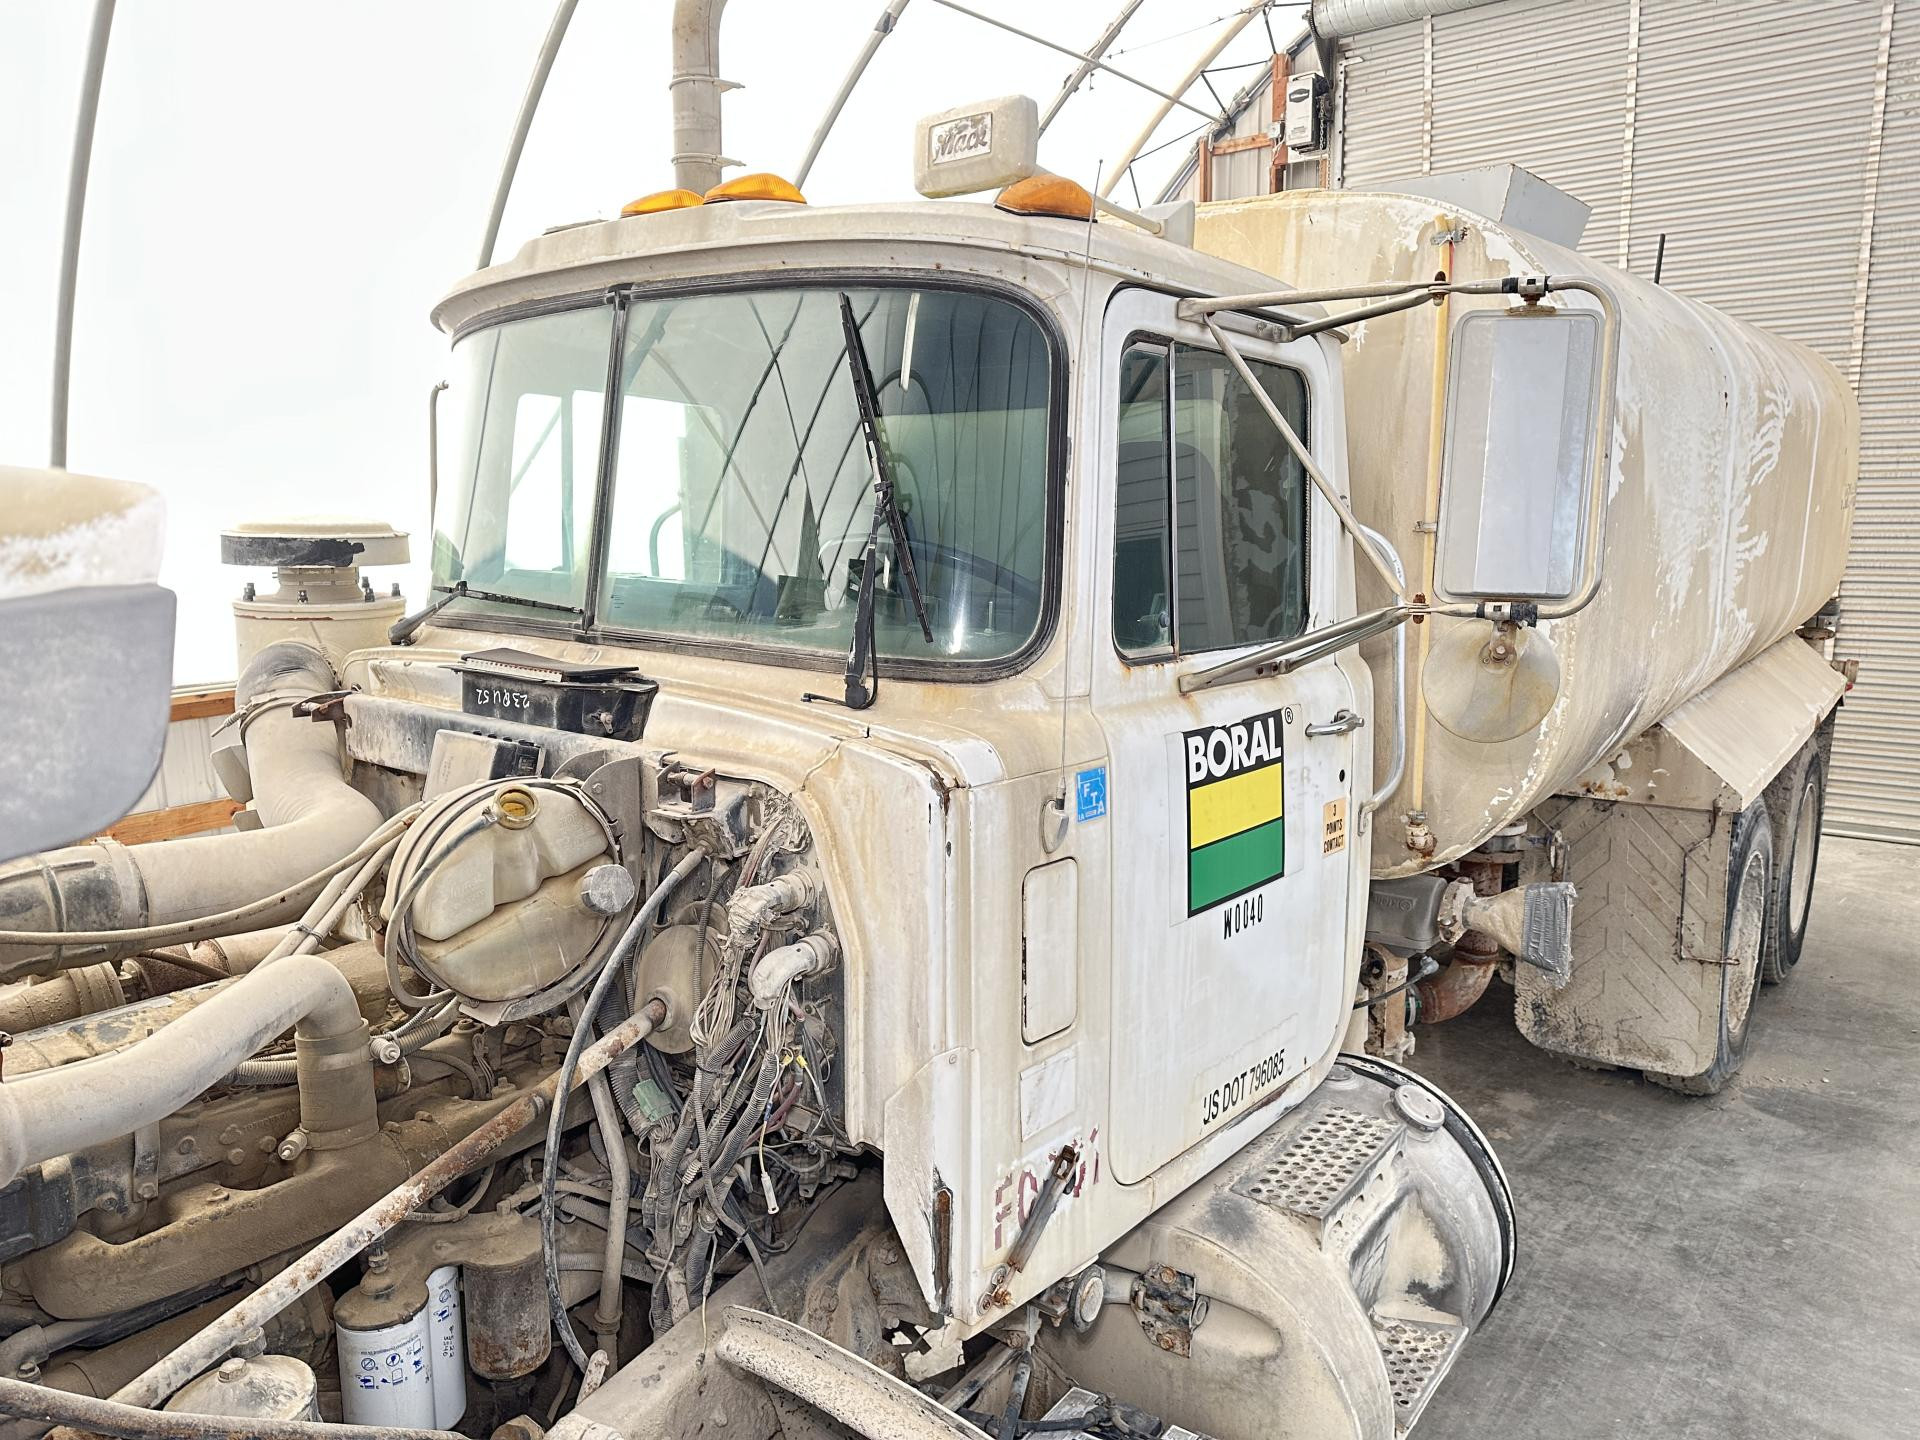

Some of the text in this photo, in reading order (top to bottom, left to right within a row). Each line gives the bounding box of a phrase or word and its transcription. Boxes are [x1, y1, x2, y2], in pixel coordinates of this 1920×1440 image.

[932, 118, 988, 161] Mack
[1187, 717, 1282, 784] BORAL
[1223, 893, 1263, 940] W0040
[1203, 1048, 1285, 1125] US DOT 796085
